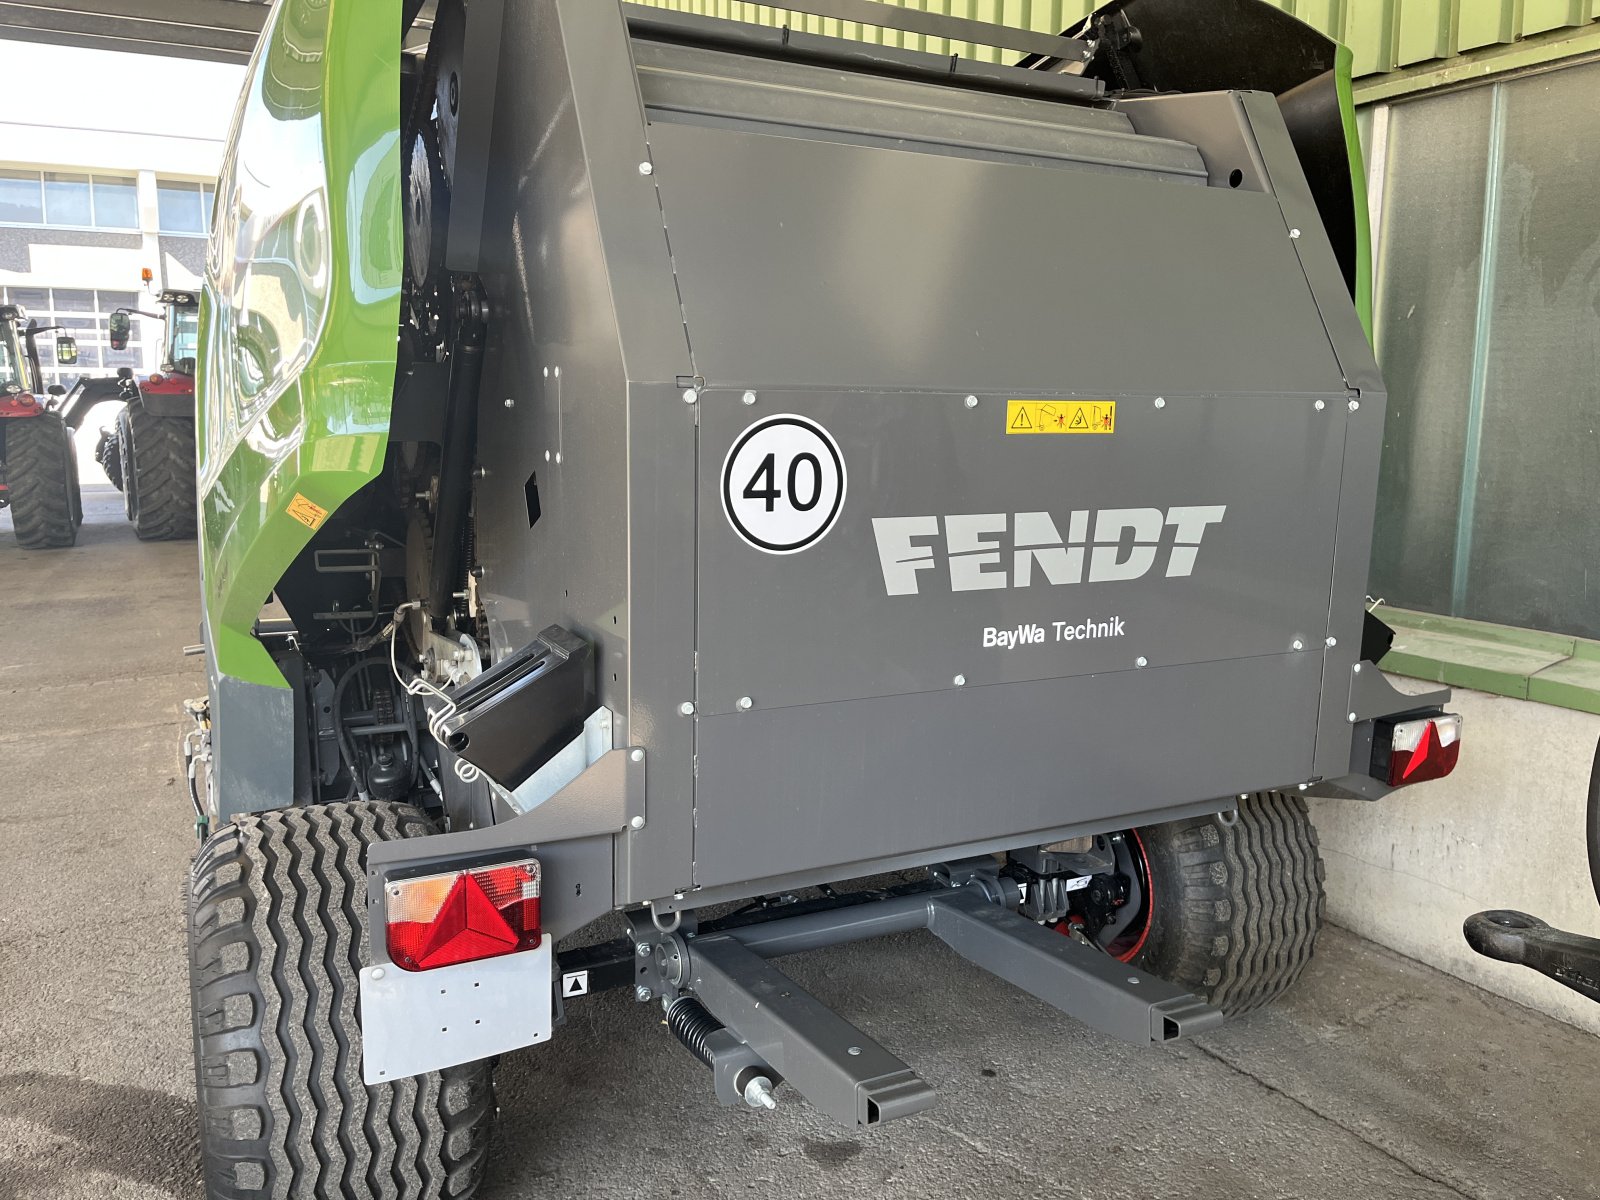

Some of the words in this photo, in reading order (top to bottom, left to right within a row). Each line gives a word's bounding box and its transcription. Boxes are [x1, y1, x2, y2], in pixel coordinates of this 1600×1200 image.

[742, 452, 823, 513] 40
[871, 504, 1227, 597] FENDT
[982, 623, 1046, 650] BayWa
[1051, 615, 1126, 643] Technik
